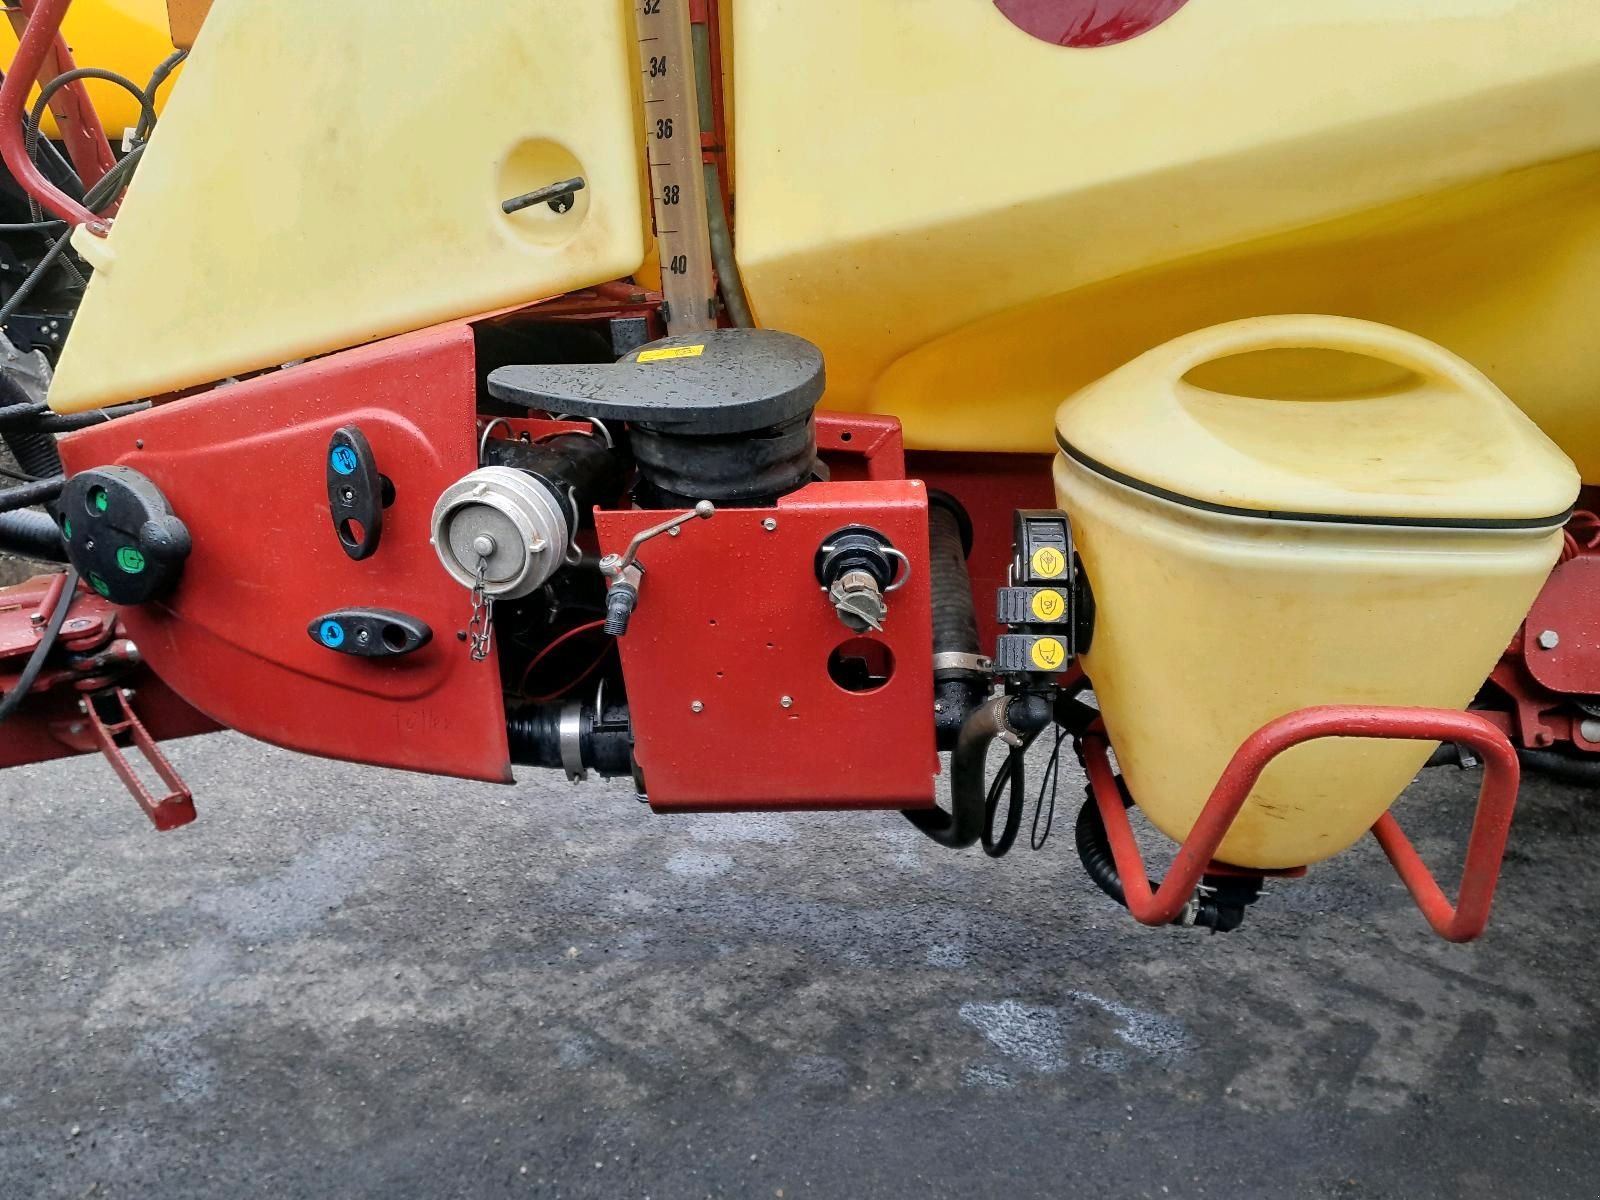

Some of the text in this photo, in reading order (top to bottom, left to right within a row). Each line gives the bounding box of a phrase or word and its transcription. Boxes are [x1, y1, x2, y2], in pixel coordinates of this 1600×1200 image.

[643, 0, 660, 15] 32
[649, 56, 666, 78] 34
[656, 118, 673, 139] 36
[663, 185, 680, 205] 38
[670, 255, 687, 275] 40
